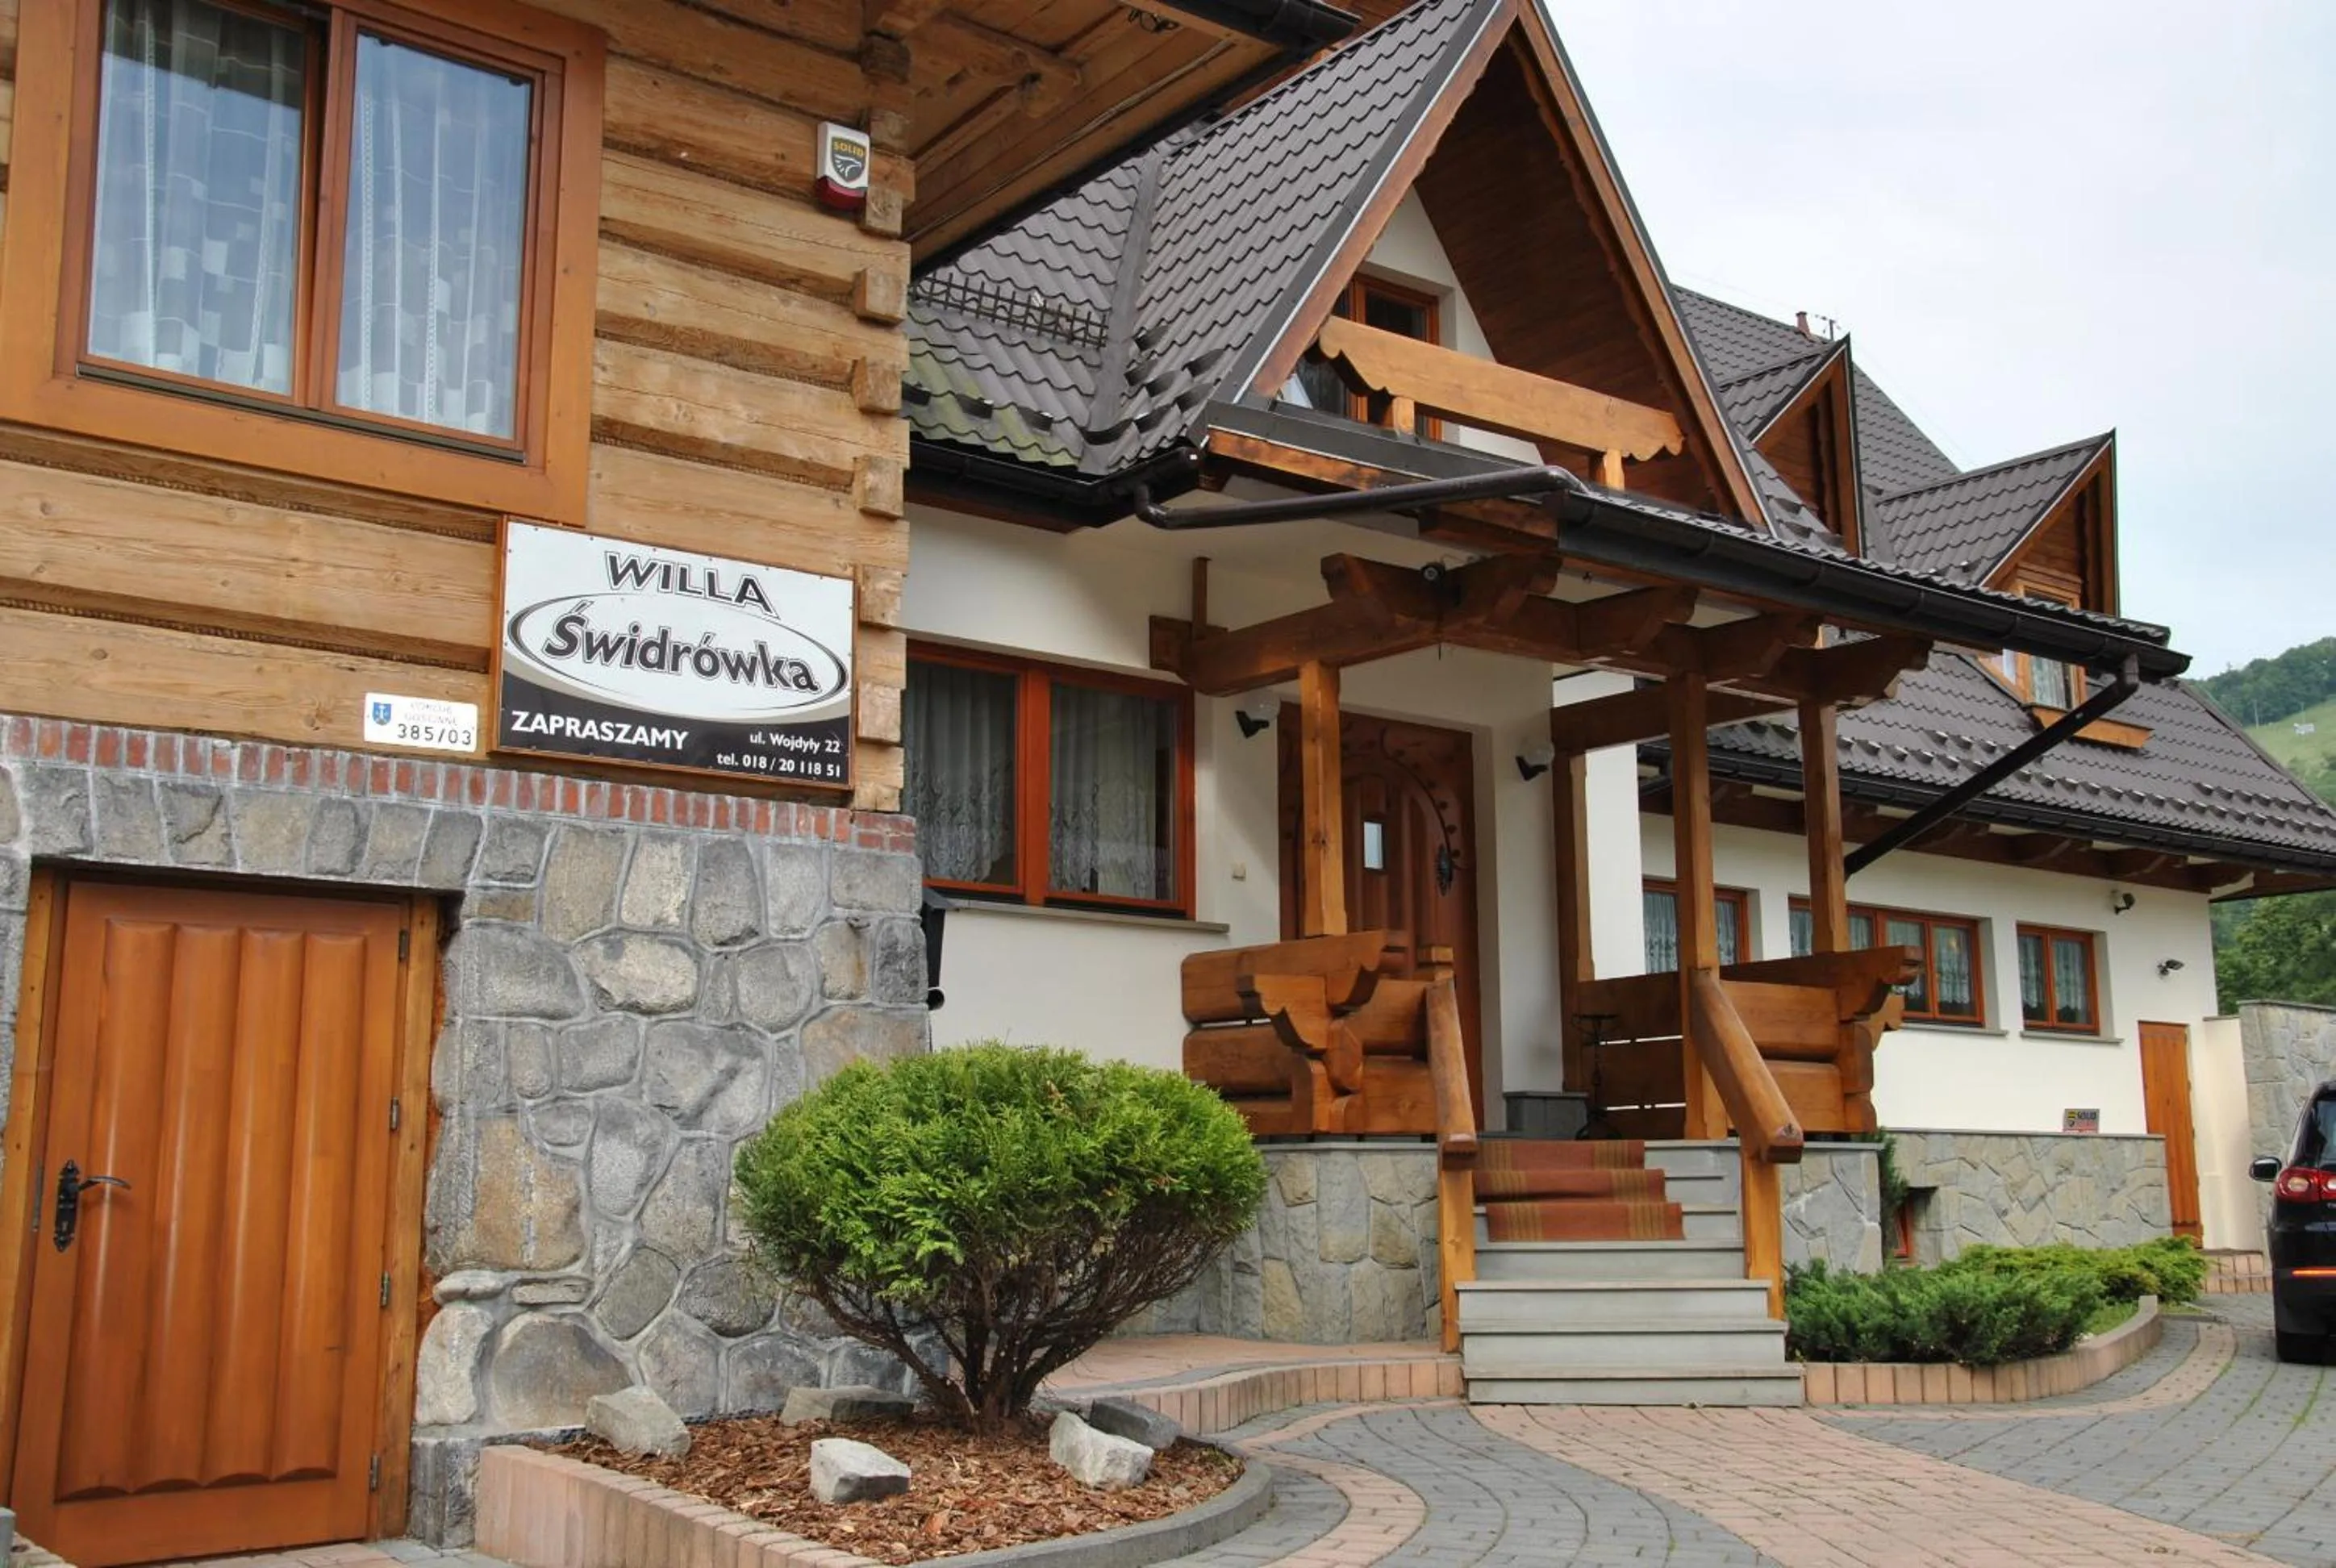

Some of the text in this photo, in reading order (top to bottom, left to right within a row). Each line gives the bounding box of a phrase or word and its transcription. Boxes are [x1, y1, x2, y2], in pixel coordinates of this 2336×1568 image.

[604, 551, 780, 619] WILLA
[540, 599, 821, 694] Świdrówka
[398, 724, 472, 745] 385/03
[511, 711, 689, 750] ZAPRASZAMY
[749, 732, 841, 754] ul. Wojdyły 22
[716, 753, 739, 766] tel.
[742, 754, 767, 769] 018
[778, 758, 795, 772] 20
[799, 761, 822, 775] 118
[826, 764, 841, 778] 51
